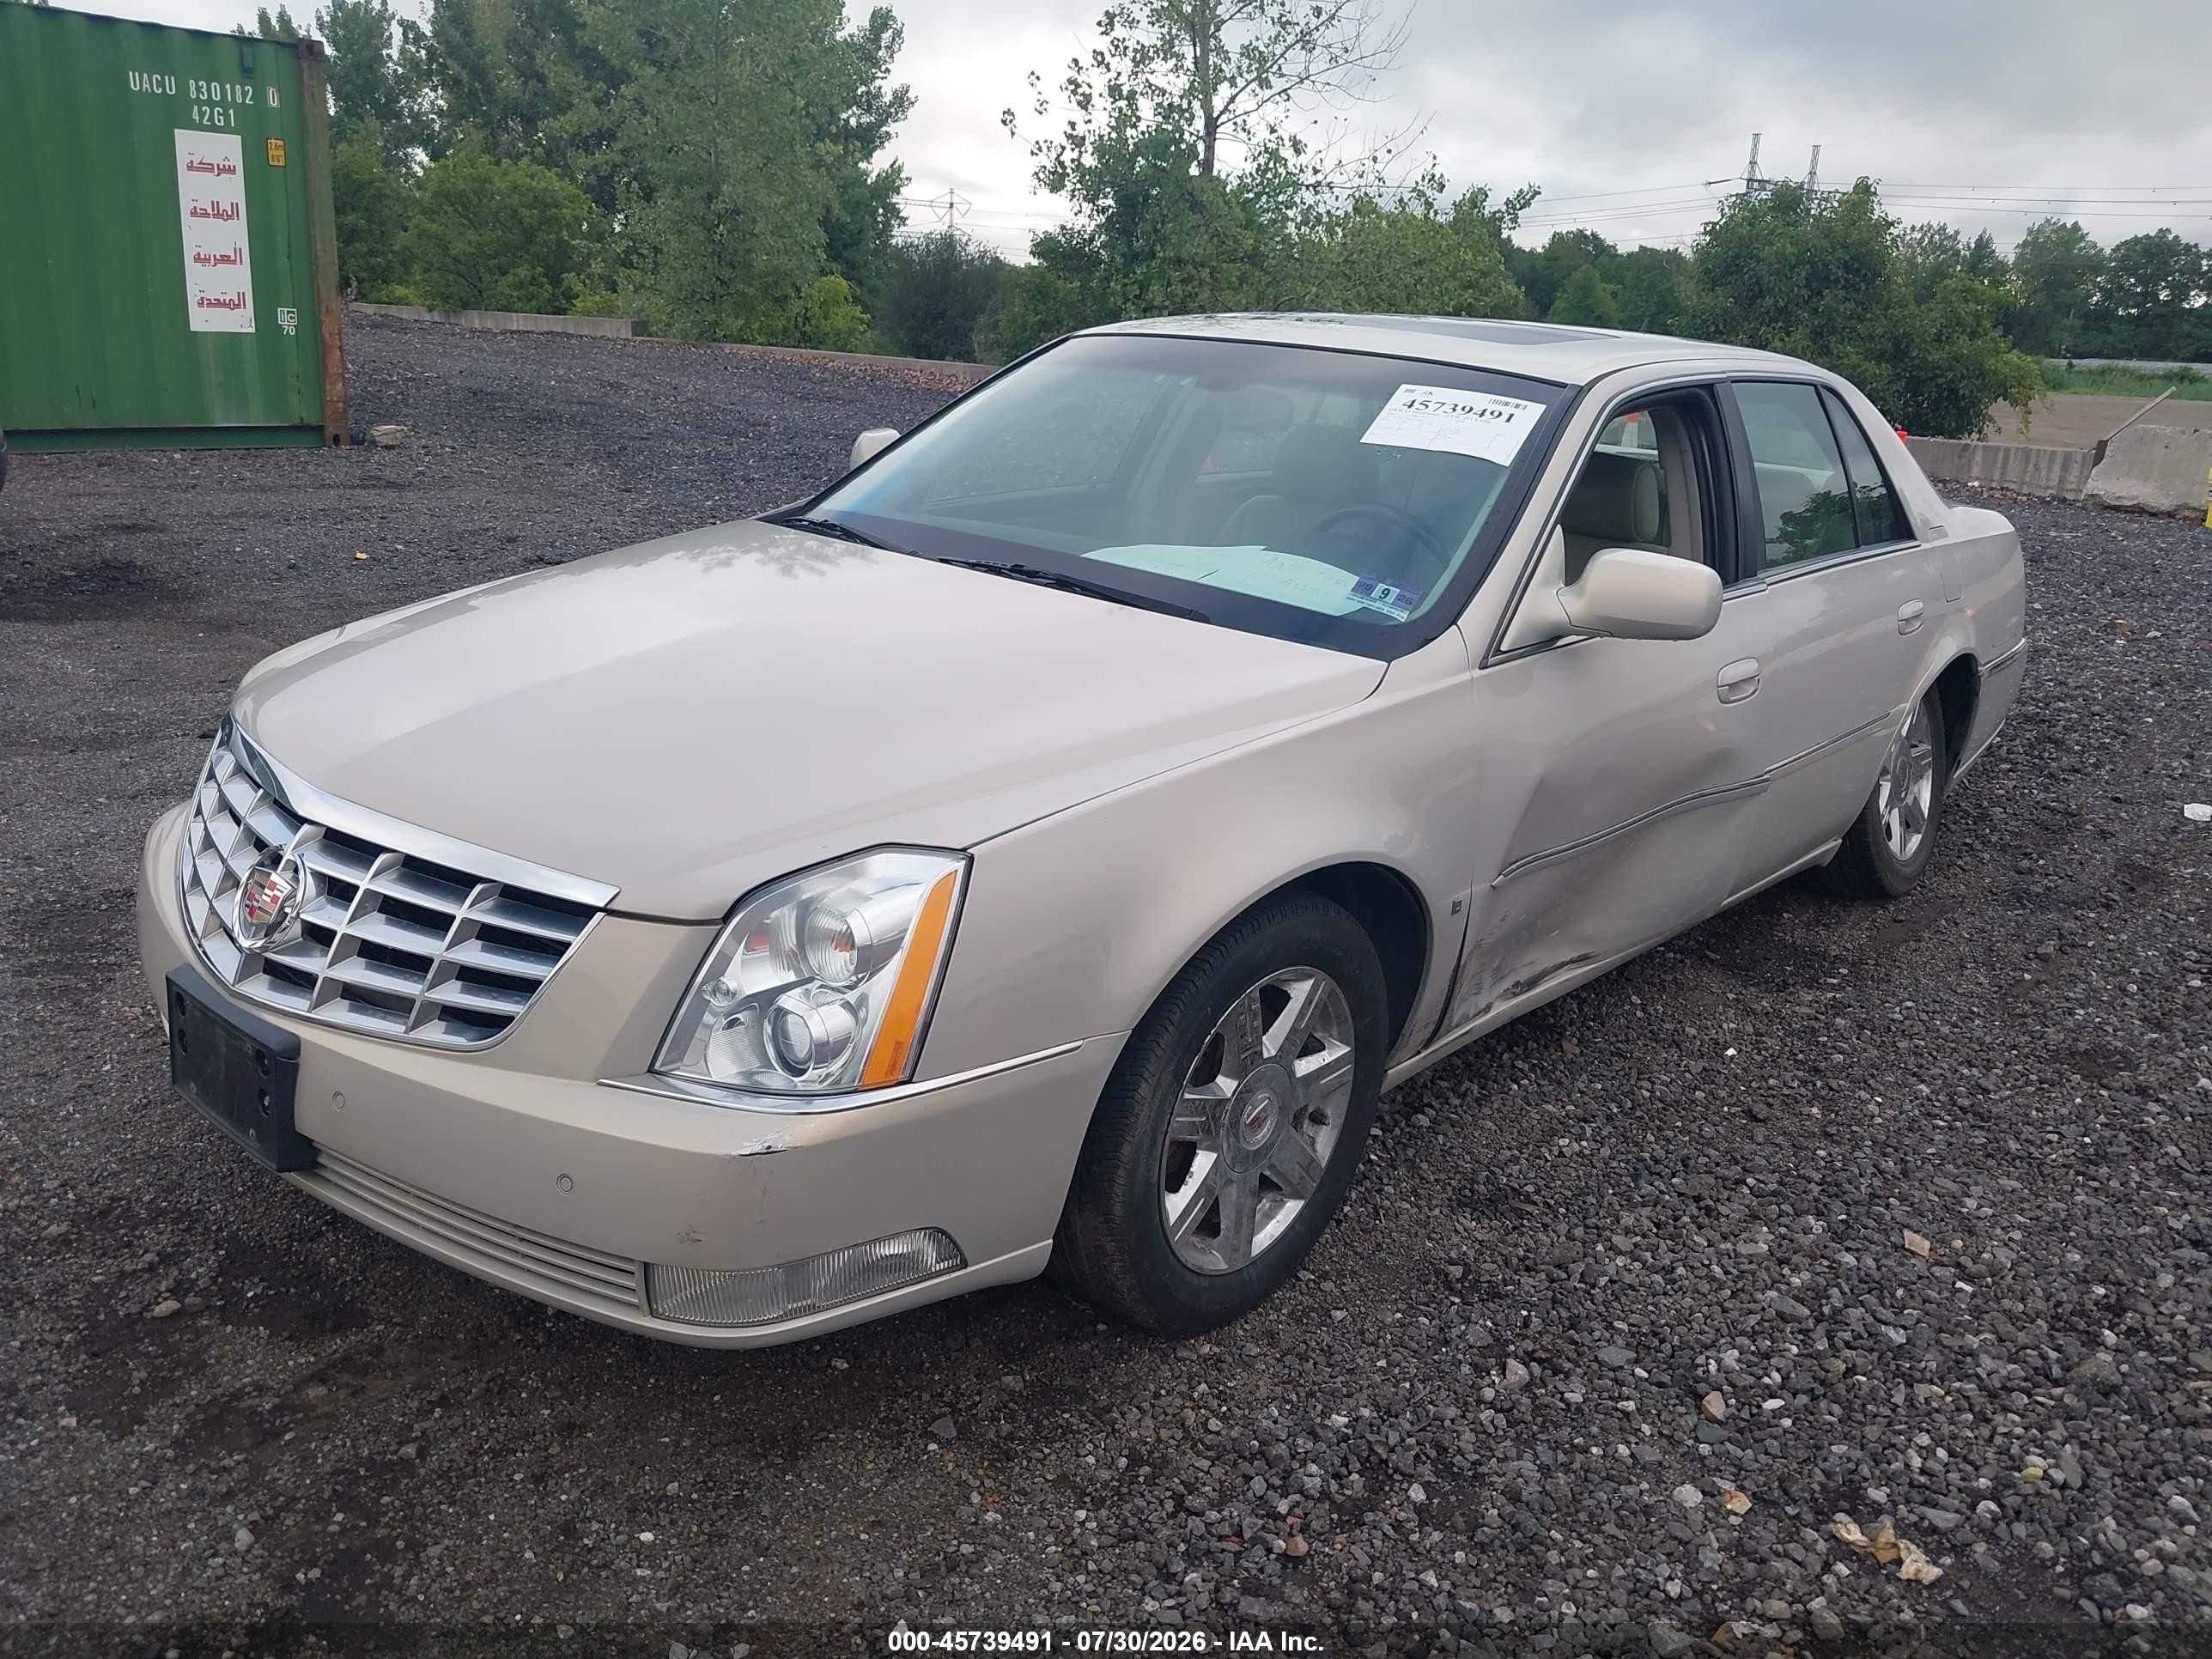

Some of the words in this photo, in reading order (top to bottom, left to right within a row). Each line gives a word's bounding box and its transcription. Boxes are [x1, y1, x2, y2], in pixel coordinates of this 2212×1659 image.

[129, 70, 176, 94] UACU
[189, 79, 254, 105] 830182
[191, 105, 235, 127] 42G1
[186, 152, 237, 177] شركة
[190, 198, 240, 222] الملاحة
[193, 243, 243, 267] العربية
[197, 289, 246, 311] المتحدة
[282, 325, 296, 336] 70
[1402, 398, 1516, 424] 45739491
[1357, 581, 1374, 592] 20
[1378, 587, 1391, 599] 9
